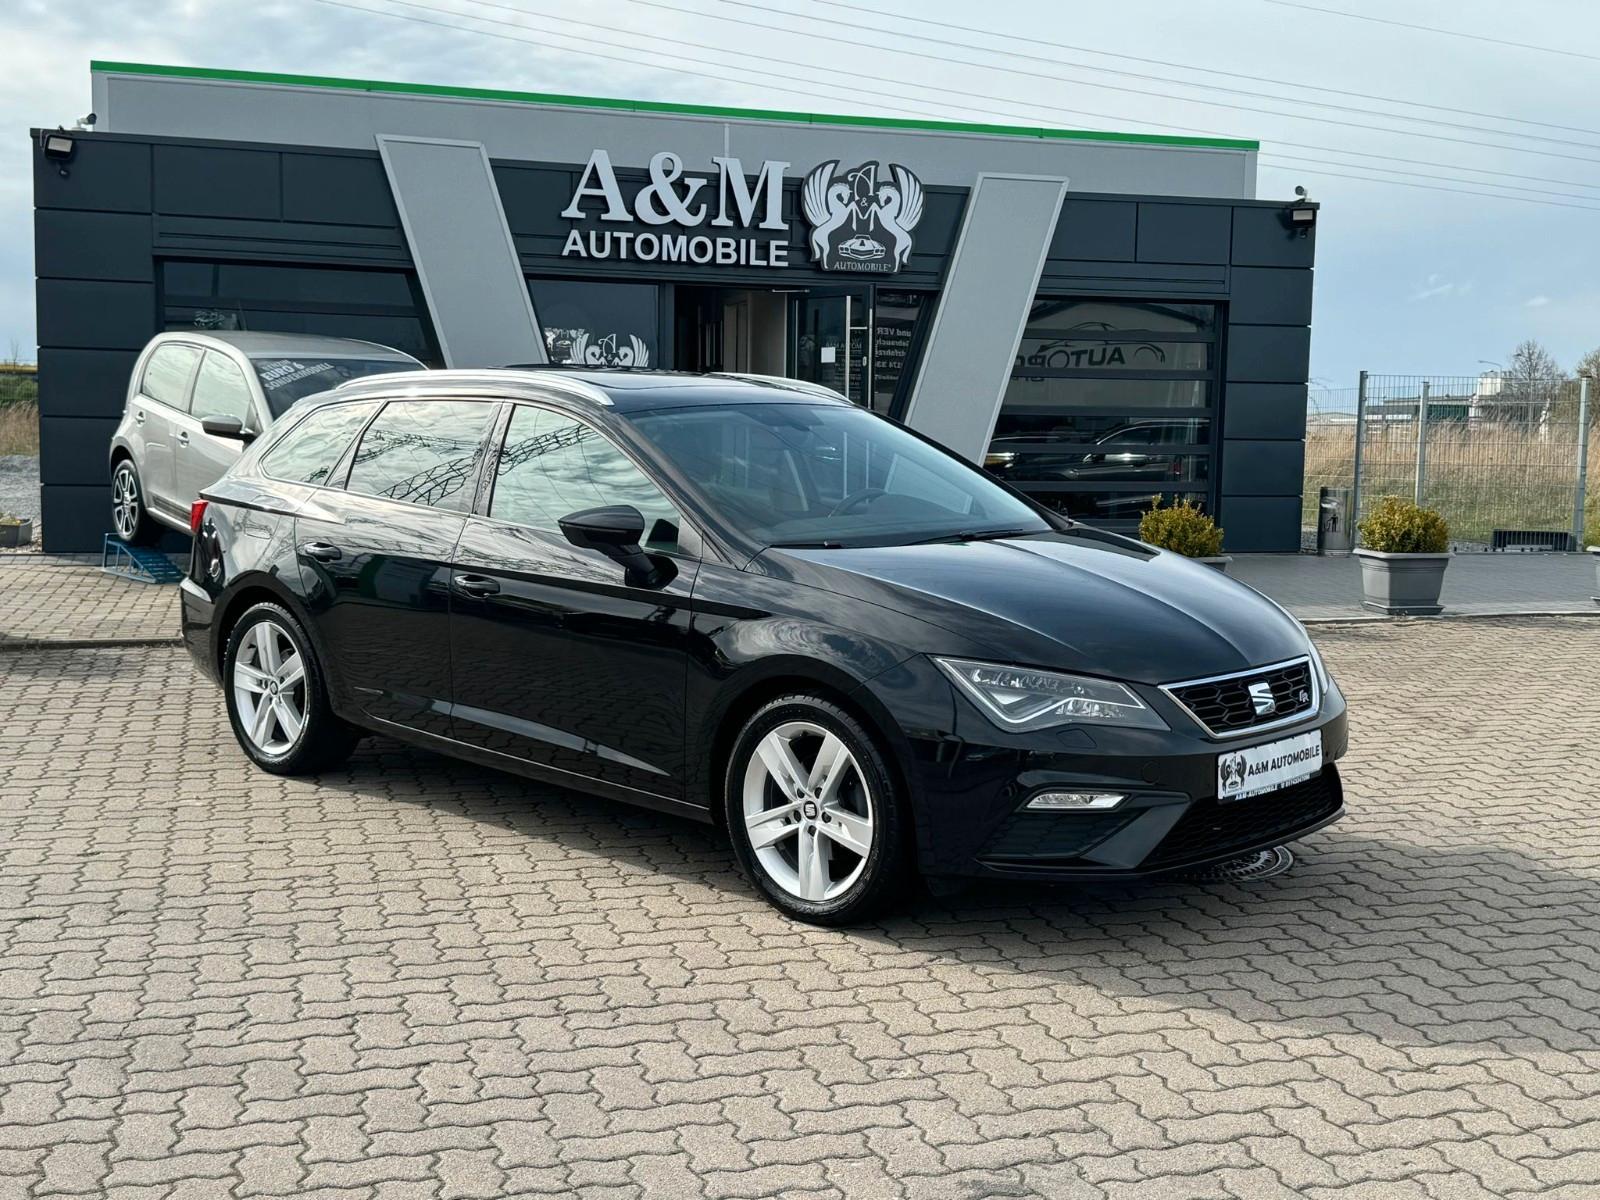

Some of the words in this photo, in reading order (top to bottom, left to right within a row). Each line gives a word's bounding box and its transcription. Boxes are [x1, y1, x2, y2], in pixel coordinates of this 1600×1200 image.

[561, 149, 791, 230] A&M
[561, 229, 789, 267] AUTOMOBILE
[260, 364, 295, 380] EURO
[292, 362, 305, 370] 6
[264, 362, 335, 390] SONDERMODELL
[1248, 760, 1269, 777] A&M
[1270, 744, 1320, 771] AUTOMOBILE
